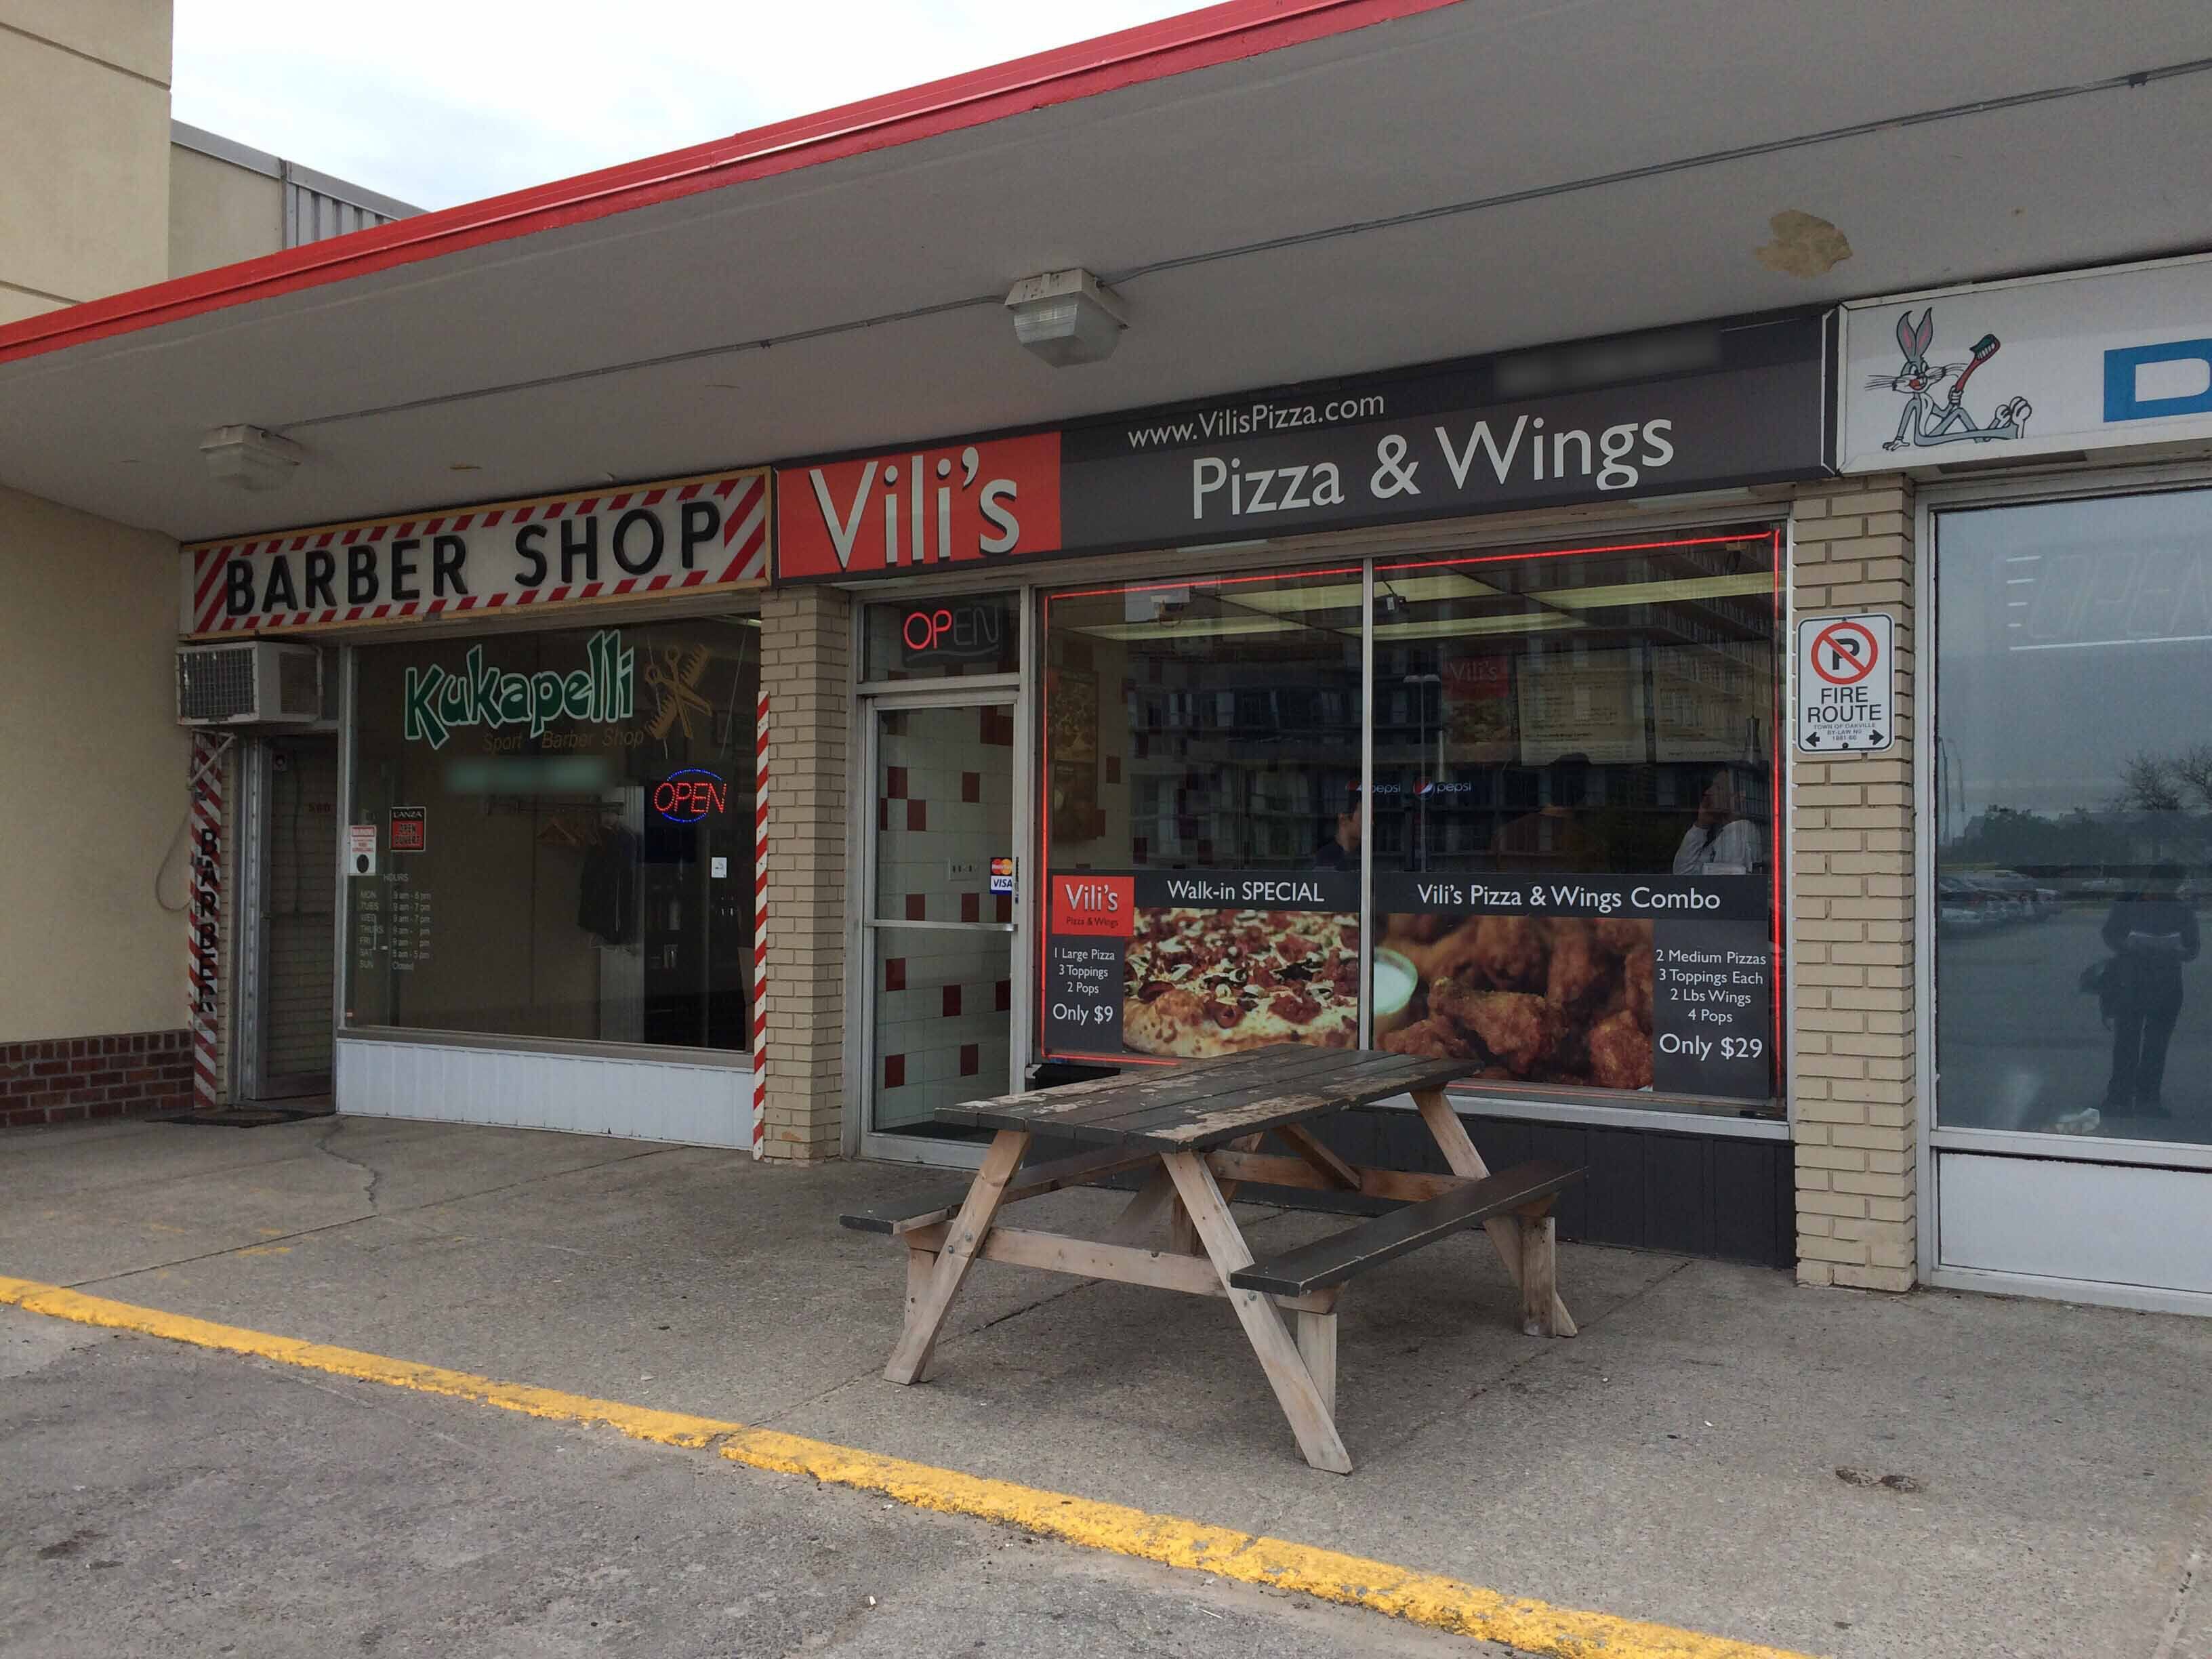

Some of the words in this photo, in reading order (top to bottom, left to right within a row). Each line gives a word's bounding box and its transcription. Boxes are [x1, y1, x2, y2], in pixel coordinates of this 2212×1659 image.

[1128, 392, 1385, 450] www.VilisPizza.com
[1191, 455, 1345, 520] Pizza
[1370, 434, 1421, 498] &
[1434, 415, 1675, 491] Wings
[809, 445, 1021, 571] Vili's
[226, 535, 468, 617] BARBER
[514, 500, 721, 588] SHOP
[903, 605, 1000, 649] OPEN
[1450, 659, 1498, 683] Vili's
[405, 629, 634, 750] Kukapelli
[1821, 686, 1868, 704] FIRE
[1807, 703, 1882, 723] ROUTE
[541, 729, 594, 749] Barber
[602, 726, 644, 750] Shop
[653, 782, 727, 813] OPEN
[1437, 781, 1472, 794] pepsi
[383, 873, 409, 882] HOURS
[993, 878, 1012, 888] VISA
[1065, 883, 1118, 912] Vili's
[1167, 880, 1235, 901] Walk-in
[1242, 881, 1325, 903] SPECIAL
[1417, 884, 1462, 905] Vili's
[1470, 884, 1523, 906] Pizza
[1530, 886, 1547, 906] &
[1550, 885, 1622, 914] Wings
[1631, 886, 1721, 909] Combo
[199, 828, 218, 1012] BARBER
[1066, 916, 1085, 925] Pizza
[1094, 916, 1119, 928] Wings
[1061, 948, 1088, 963] Large
[1091, 948, 1115, 960] Pizza
[1656, 949, 1664, 962] 2
[1668, 949, 1722, 964] Medium
[1726, 951, 1767, 966] Pizzas
[1059, 964, 1065, 976] 3
[1066, 964, 1109, 979] Toppings
[1658, 968, 1666, 982] 3
[1668, 968, 1727, 986] Toppings
[1732, 970, 1763, 985] Each
[1067, 982, 1073, 993] 2
[1076, 982, 1099, 996] Pops
[1670, 988, 1679, 1001] 2
[1682, 988, 1706, 1002] Lbs
[1708, 989, 1752, 1006] Wings
[1052, 1003, 1088, 1026] Only
[1094, 1004, 1113, 1025] $9
[1687, 1008, 1696, 1021] 4
[1700, 1009, 1734, 1025] Pops
[1659, 1033, 1713, 1061] Only
[1720, 1037, 1763, 1061] $29
